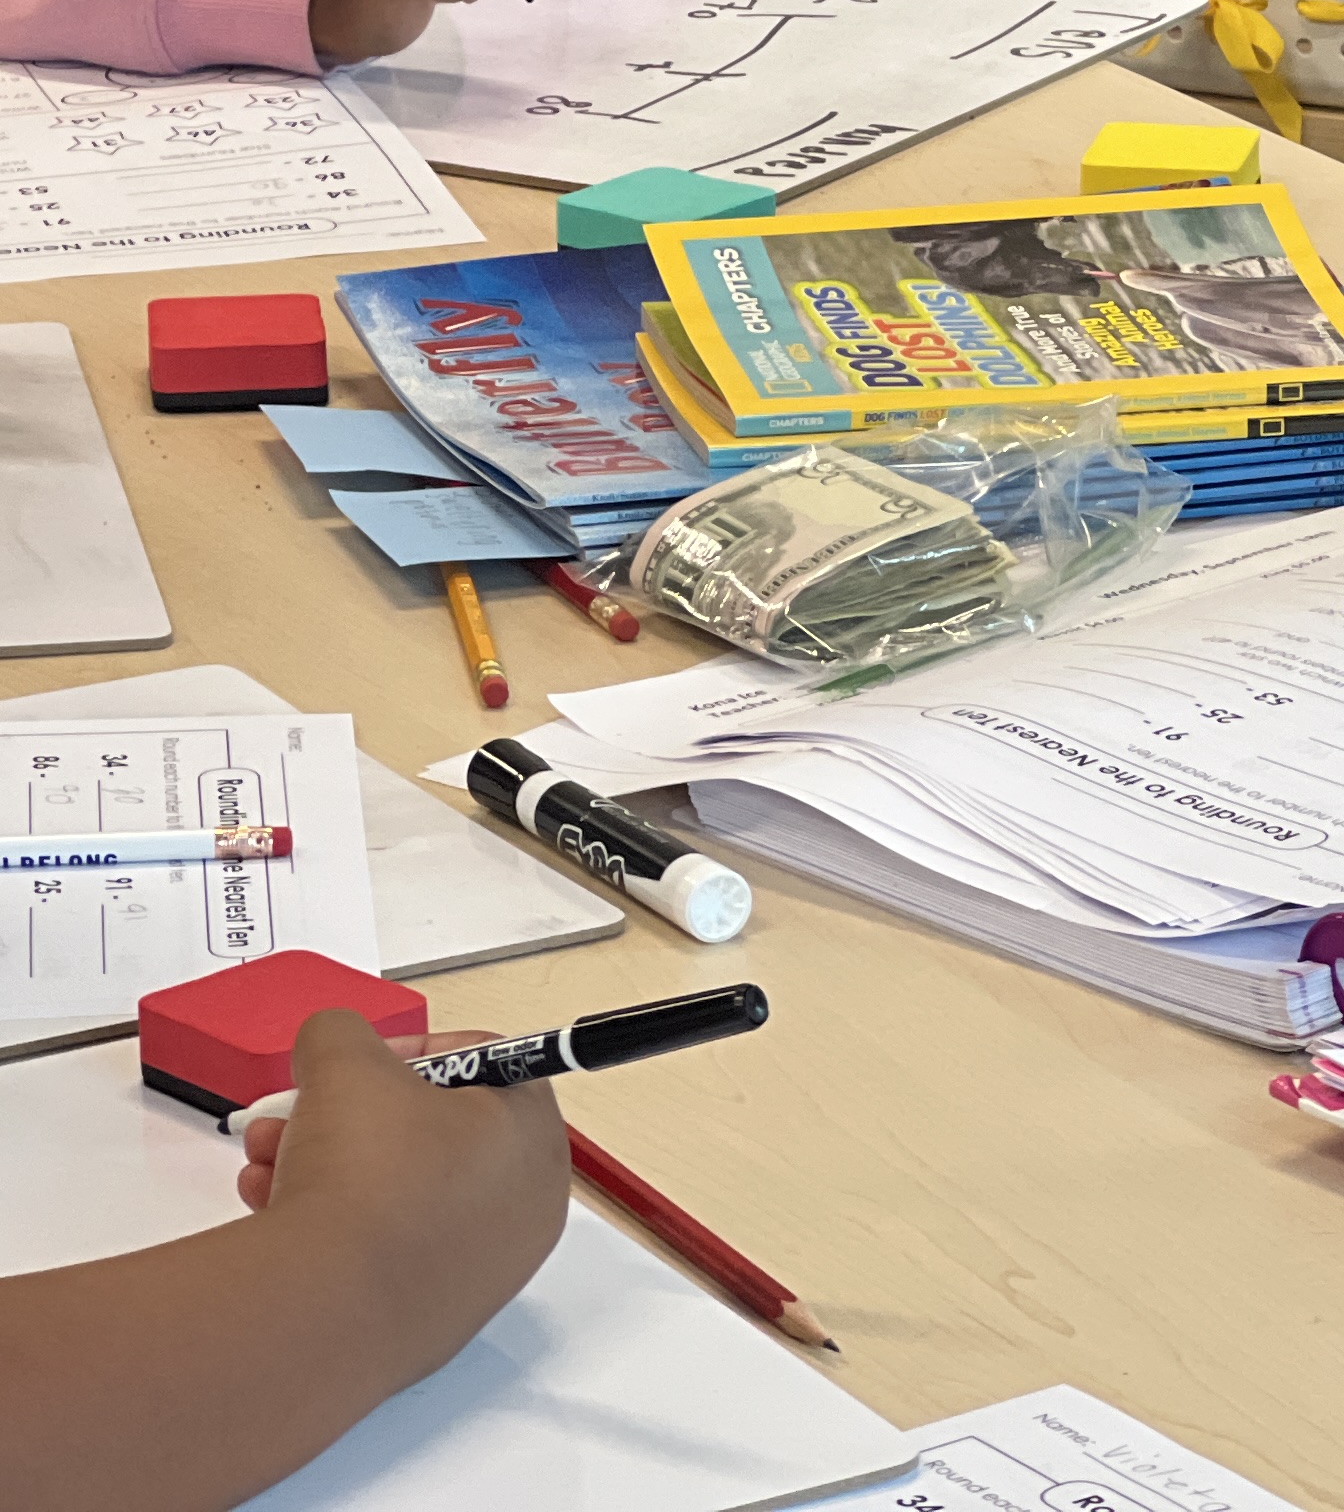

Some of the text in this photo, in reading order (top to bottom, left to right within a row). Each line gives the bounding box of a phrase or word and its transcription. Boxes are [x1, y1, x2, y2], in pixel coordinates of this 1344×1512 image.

[91, 237, 136, 248] the
[144, 233, 171, 243] to
[178, 220, 311, 240] Rounding
[713, 247, 772, 334] CHAPTERS
[804, 285, 879, 340] FINDS
[1006, 305, 1038, 331] True
[1089, 300, 1150, 344] Animal
[1130, 308, 1184, 352] Heroes
[873, 318, 974, 374] LOST
[909, 283, 1042, 387] DOLPHINS!
[1028, 330, 1063, 356] More
[1038, 312, 1099, 360] Stories of
[1077, 316, 1142, 367] Amazing
[835, 344, 925, 388] DOG
[413, 297, 673, 477] Butterfly
[768, 416, 825, 428] CHAPTERS
[864, 411, 886, 424] DOG
[885, 409, 919, 423] FINDS
[918, 407, 948, 421] LOST
[879, 497, 918, 519] 5
[161, 737, 184, 815] Round each number
[951, 707, 1300, 842] Rounding to the Nearest Ten
[1153, 754, 1216, 785] nearest
[1212, 777, 1247, 795] the
[1246, 789, 1265, 802] to
[1264, 795, 1332, 827] number
[223, 876, 254, 923] Nearest
[226, 924, 255, 949] Ten
[489, 1042, 513, 1060] low
[512, 1036, 545, 1057] odor
[1032, 1412, 1097, 1448] Name:
[923, 1458, 991, 1494] Round
